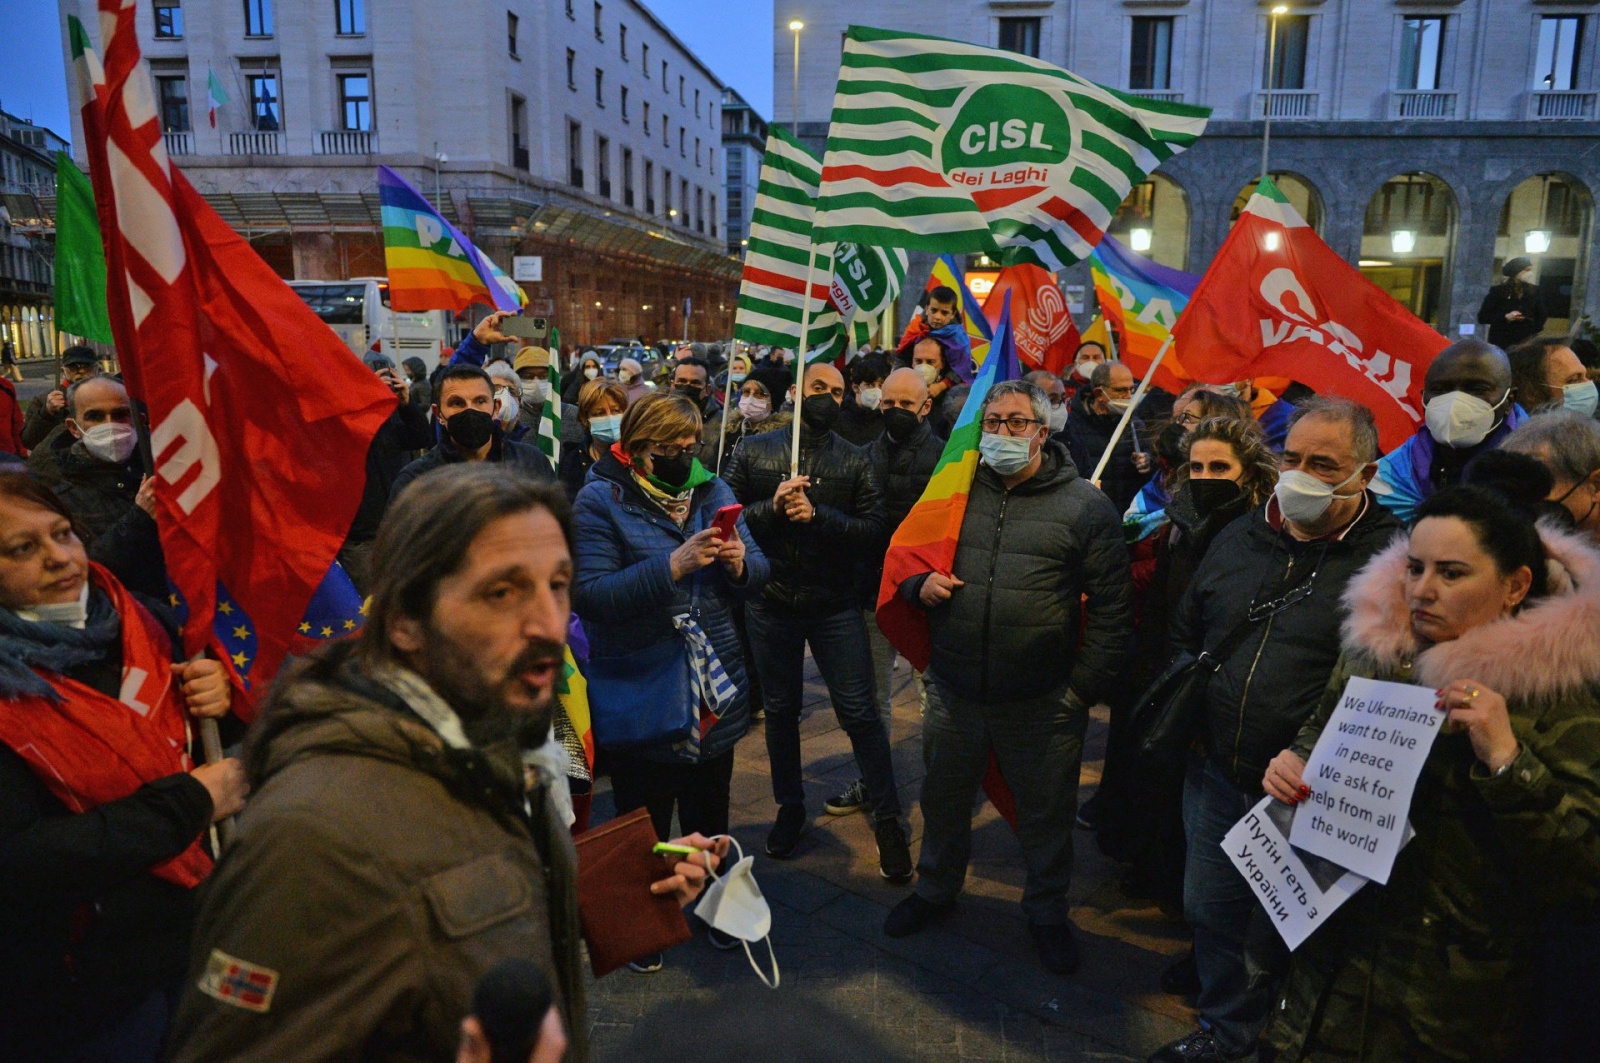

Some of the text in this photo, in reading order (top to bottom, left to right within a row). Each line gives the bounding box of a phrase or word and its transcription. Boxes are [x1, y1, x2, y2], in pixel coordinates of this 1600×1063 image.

[959, 118, 1053, 155] CISL
[952, 166, 1049, 186] dei Laghi
[831, 280, 854, 310] aghi
[1344, 695, 1437, 727] We Ukranians
[1338, 720, 1417, 750] want to live
[1334, 743, 1394, 772] in peace
[1319, 763, 1395, 801] We ask for
[1306, 785, 1396, 831] help from all
[1311, 816, 1379, 854] the world
[1244, 813, 1282, 865] Путін
[1280, 864, 1308, 906] геть
[1237, 844, 1290, 922] України
